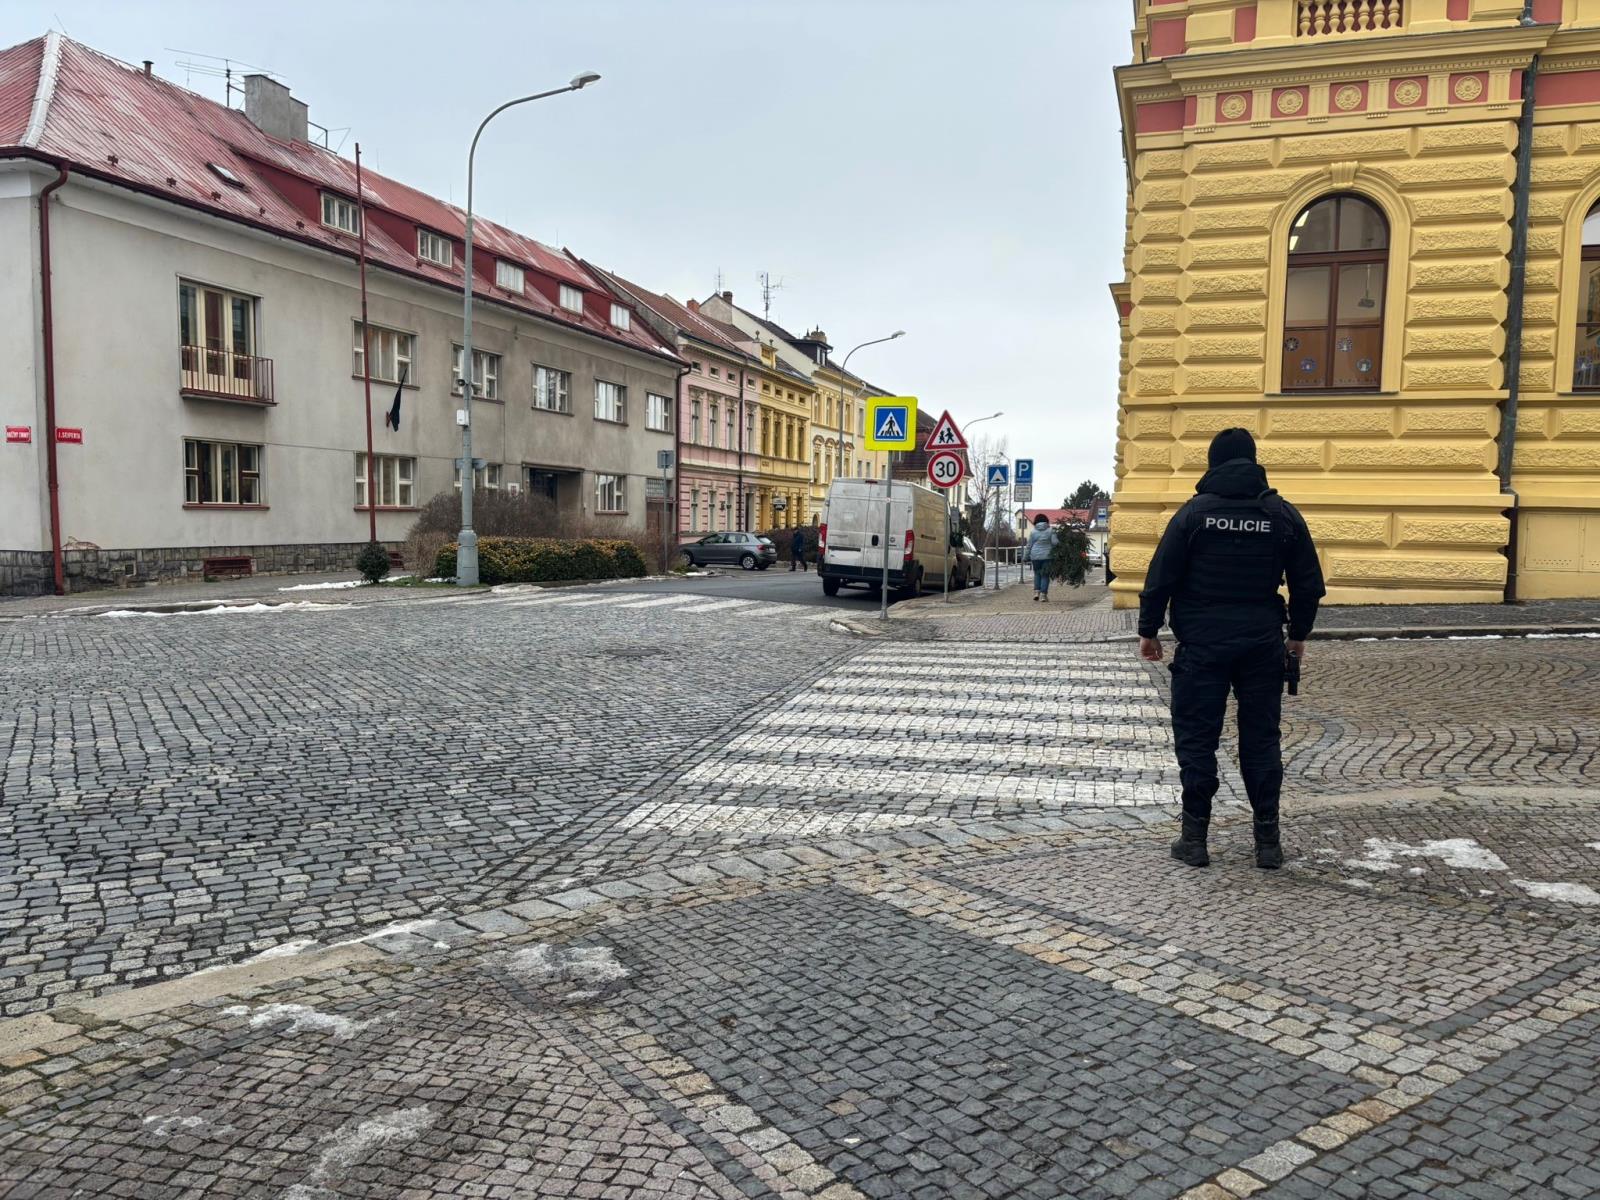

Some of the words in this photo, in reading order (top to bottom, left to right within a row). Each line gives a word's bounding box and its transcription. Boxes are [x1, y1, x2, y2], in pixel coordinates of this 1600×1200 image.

[935, 461, 956, 478] 30
[1018, 462, 1029, 477] P
[1205, 517, 1271, 533] POLICIE
